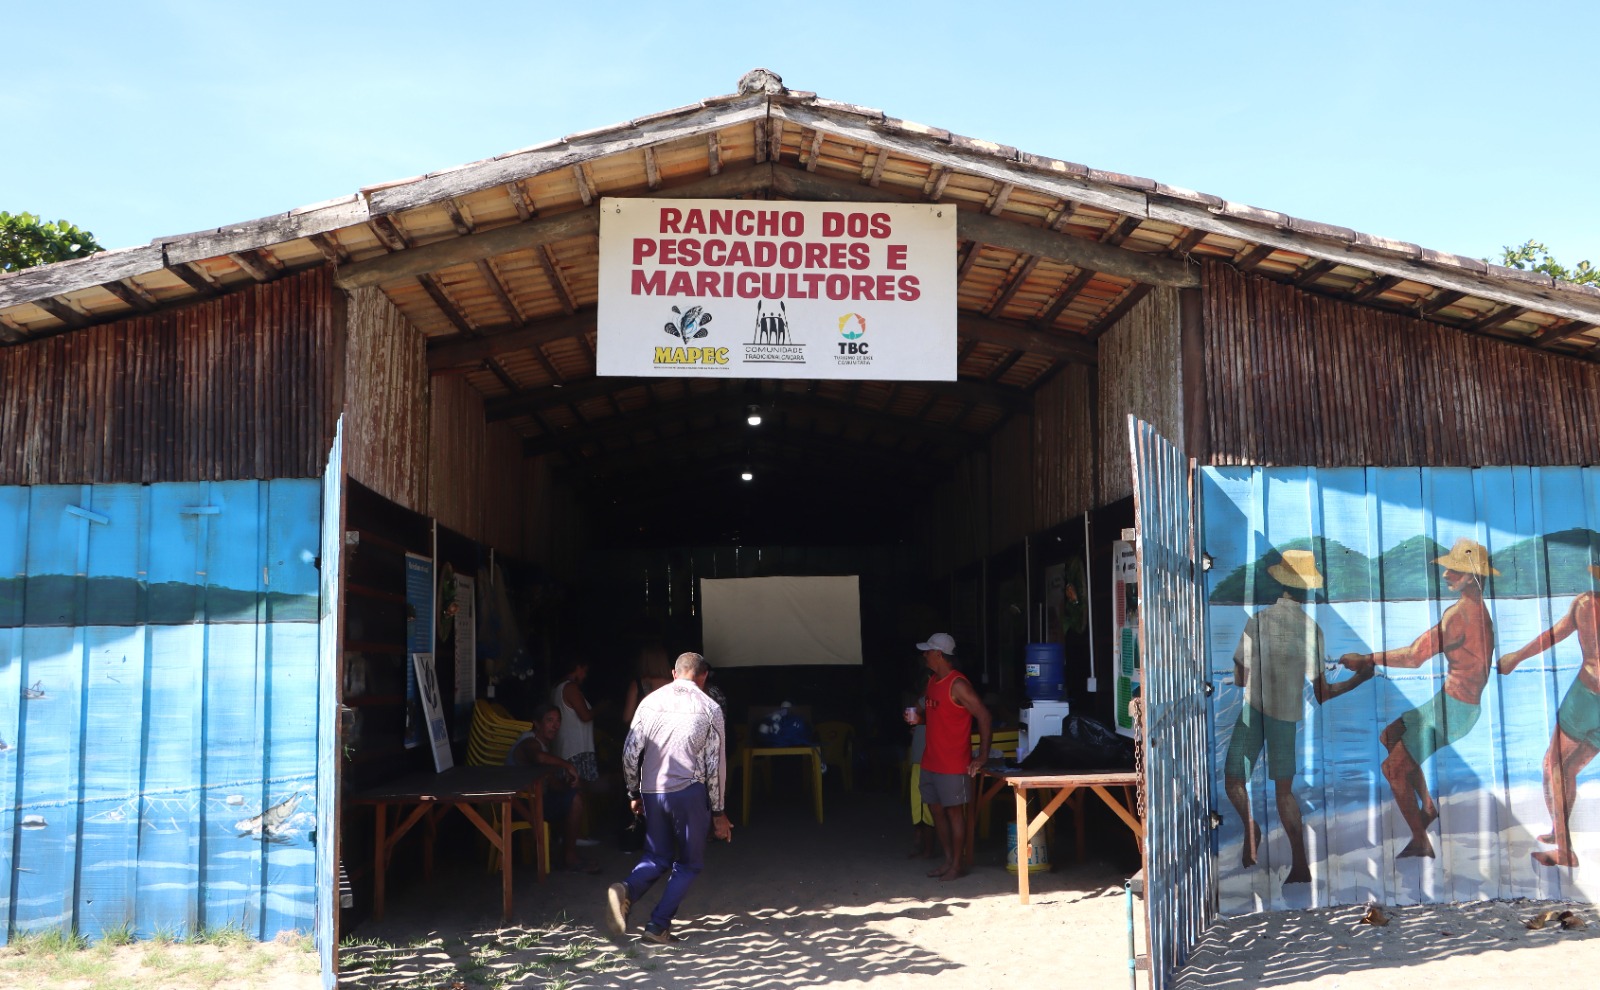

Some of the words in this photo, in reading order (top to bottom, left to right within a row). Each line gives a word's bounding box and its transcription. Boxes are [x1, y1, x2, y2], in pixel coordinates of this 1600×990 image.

[660, 207, 805, 237] RANCHO
[822, 211, 892, 239] DOS
[632, 238, 871, 270] PESCADORES
[887, 244, 908, 270] E
[631, 269, 921, 301] MARICULTORES
[653, 346, 730, 365] MAPEC
[838, 342, 869, 355] TBC
